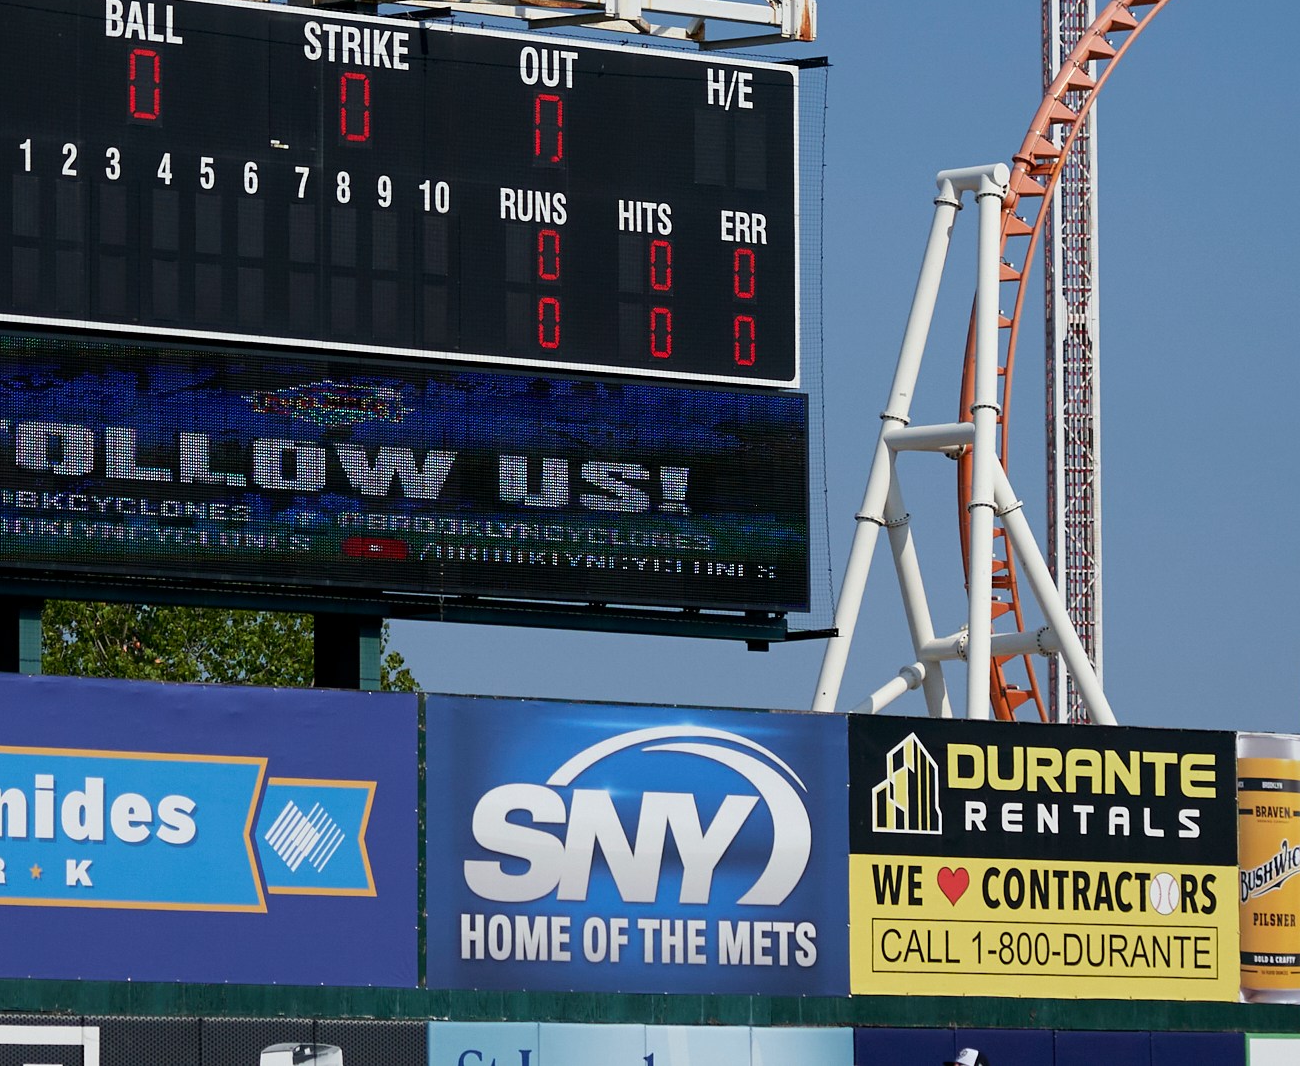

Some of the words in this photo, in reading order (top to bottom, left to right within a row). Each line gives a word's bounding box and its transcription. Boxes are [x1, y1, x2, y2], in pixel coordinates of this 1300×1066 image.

[303, 21, 410, 71] STRIKE
[520, 46, 578, 89] OUT
[129, 48, 161, 120] 0
[706, 68, 754, 111] H/E
[340, 72, 370, 142] 0
[19, 139, 32, 172] 1
[61, 143, 78, 177] 2
[105, 147, 121, 181] 3
[157, 153, 173, 185] 4
[199, 157, 215, 190] 5
[243, 161, 259, 195] 6
[295, 166, 310, 198] 7
[336, 171, 352, 204] 8
[377, 175, 392, 207] 9
[419, 180, 450, 214] 10
[500, 187, 567, 226] RUNS
[618, 200, 672, 236] HITS
[721, 210, 767, 245] ERR
[538, 229, 560, 281] 0
[650, 239, 672, 291] 0
[734, 248, 755, 299] 0
[538, 297, 560, 349] 0
[650, 307, 672, 359] 0
[734, 315, 756, 366] 0
[498, 454, 690, 515] US!
[947, 743, 1216, 798] DURANTE
[964, 800, 1201, 839] RENTALS
[1256, 806, 1291, 818] BRAVEN
[464, 783, 760, 904] SNY
[872, 864, 923, 906] WE
[460, 914, 571, 962] HOME
[583, 917, 629, 963] OF
[638, 918, 706, 965] THE
[718, 920, 817, 967] METS
[1253, 912, 1296, 927] PILSNER
[880, 929, 961, 964] CALL
[971, 930, 1212, 970] 1-800-DURANTE
[1254, 955, 1268, 964] BOLD
[1275, 955, 1296, 964] CRAFTY
